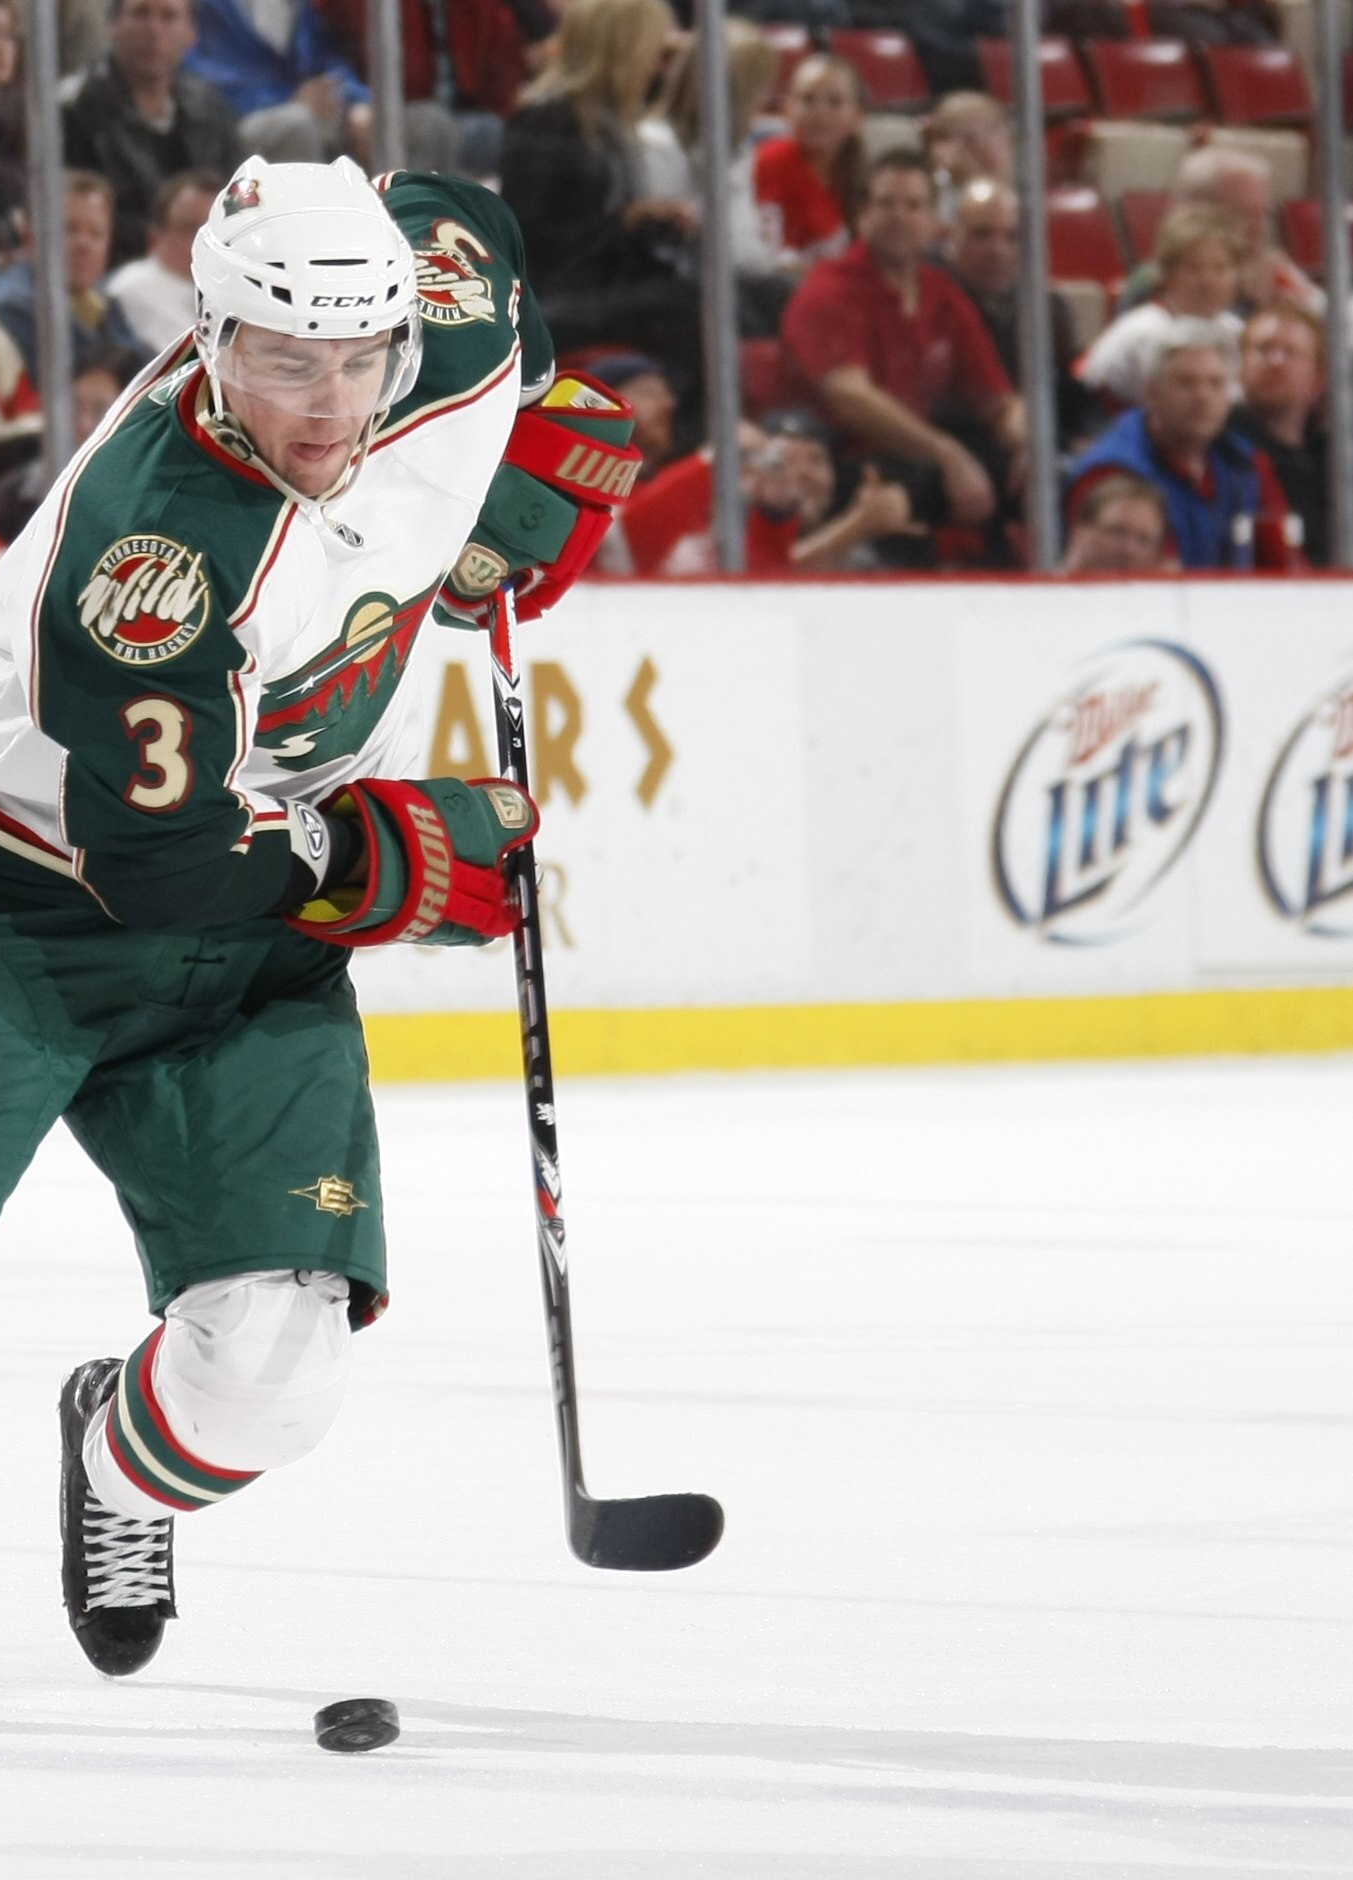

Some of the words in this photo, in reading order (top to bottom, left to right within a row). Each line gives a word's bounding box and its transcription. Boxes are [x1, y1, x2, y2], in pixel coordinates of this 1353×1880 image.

[310, 294, 376, 308] CCM
[555, 443, 642, 498] WA
[76, 545, 209, 638] Wild
[101, 540, 177, 573] MINNESOTA
[113, 642, 143, 661] NHL
[147, 622, 198, 660] HOCKEY
[121, 693, 193, 813] 3
[427, 654, 675, 812] ARS
[512, 737, 523, 749] 3
[1042, 722, 1191, 920] Lite
[398, 803, 450, 941] RRIOR
